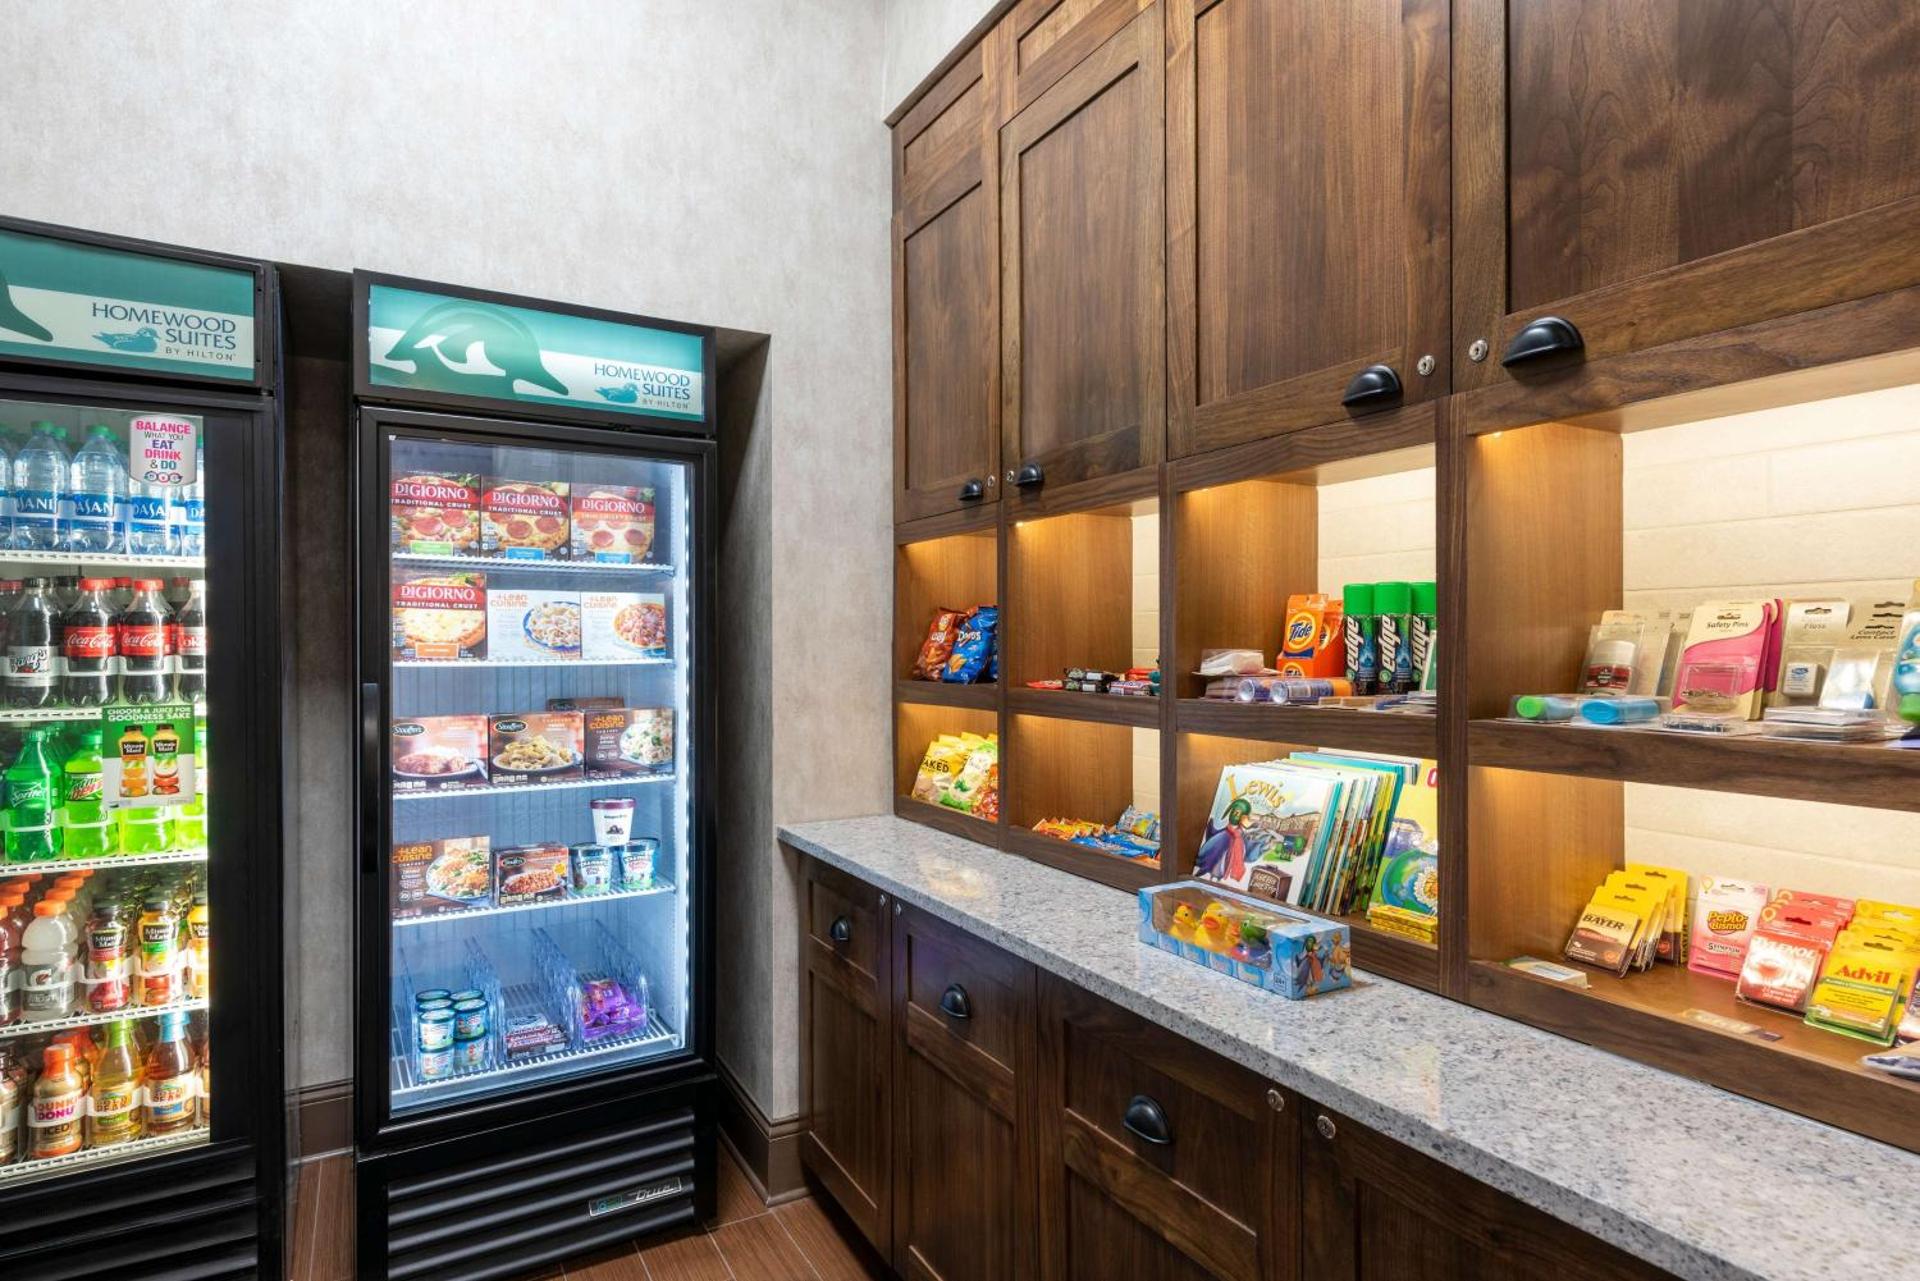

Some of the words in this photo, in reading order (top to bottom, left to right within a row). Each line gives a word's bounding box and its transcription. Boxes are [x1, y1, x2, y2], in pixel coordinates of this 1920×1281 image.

[92, 302, 236, 333] HOMEWOOD
[165, 328, 236, 350] SUITES
[165, 347, 180, 355] BY
[187, 349, 236, 361] HILTON
[594, 363, 690, 386] HOMEWOOD
[642, 383, 691, 400] SUITES
[657, 401, 689, 409] HILTON
[136, 420, 191, 435] BALANCE
[144, 431, 165, 439] WHAT
[153, 439, 174, 449] EAT
[145, 448, 181, 460] DRINK
[150, 459, 158, 469] &
[160, 460, 177, 470] DO
[488, 505, 536, 515] TRADITIONAL
[396, 601, 450, 609] TRADITIONAL
[1288, 621, 1313, 642] Tide
[1706, 621, 1731, 629] Safety
[1345, 615, 1364, 673] edge
[1378, 614, 1400, 673] edge
[1411, 614, 1432, 673] edge
[108, 713, 165, 722] GOODNESS
[166, 712, 191, 720] SAKE
[1227, 773, 1286, 809] Lewis
[1583, 914, 1625, 930] BAYER
[1710, 920, 1748, 931] Bismol
[1835, 965, 1891, 984] Advil
